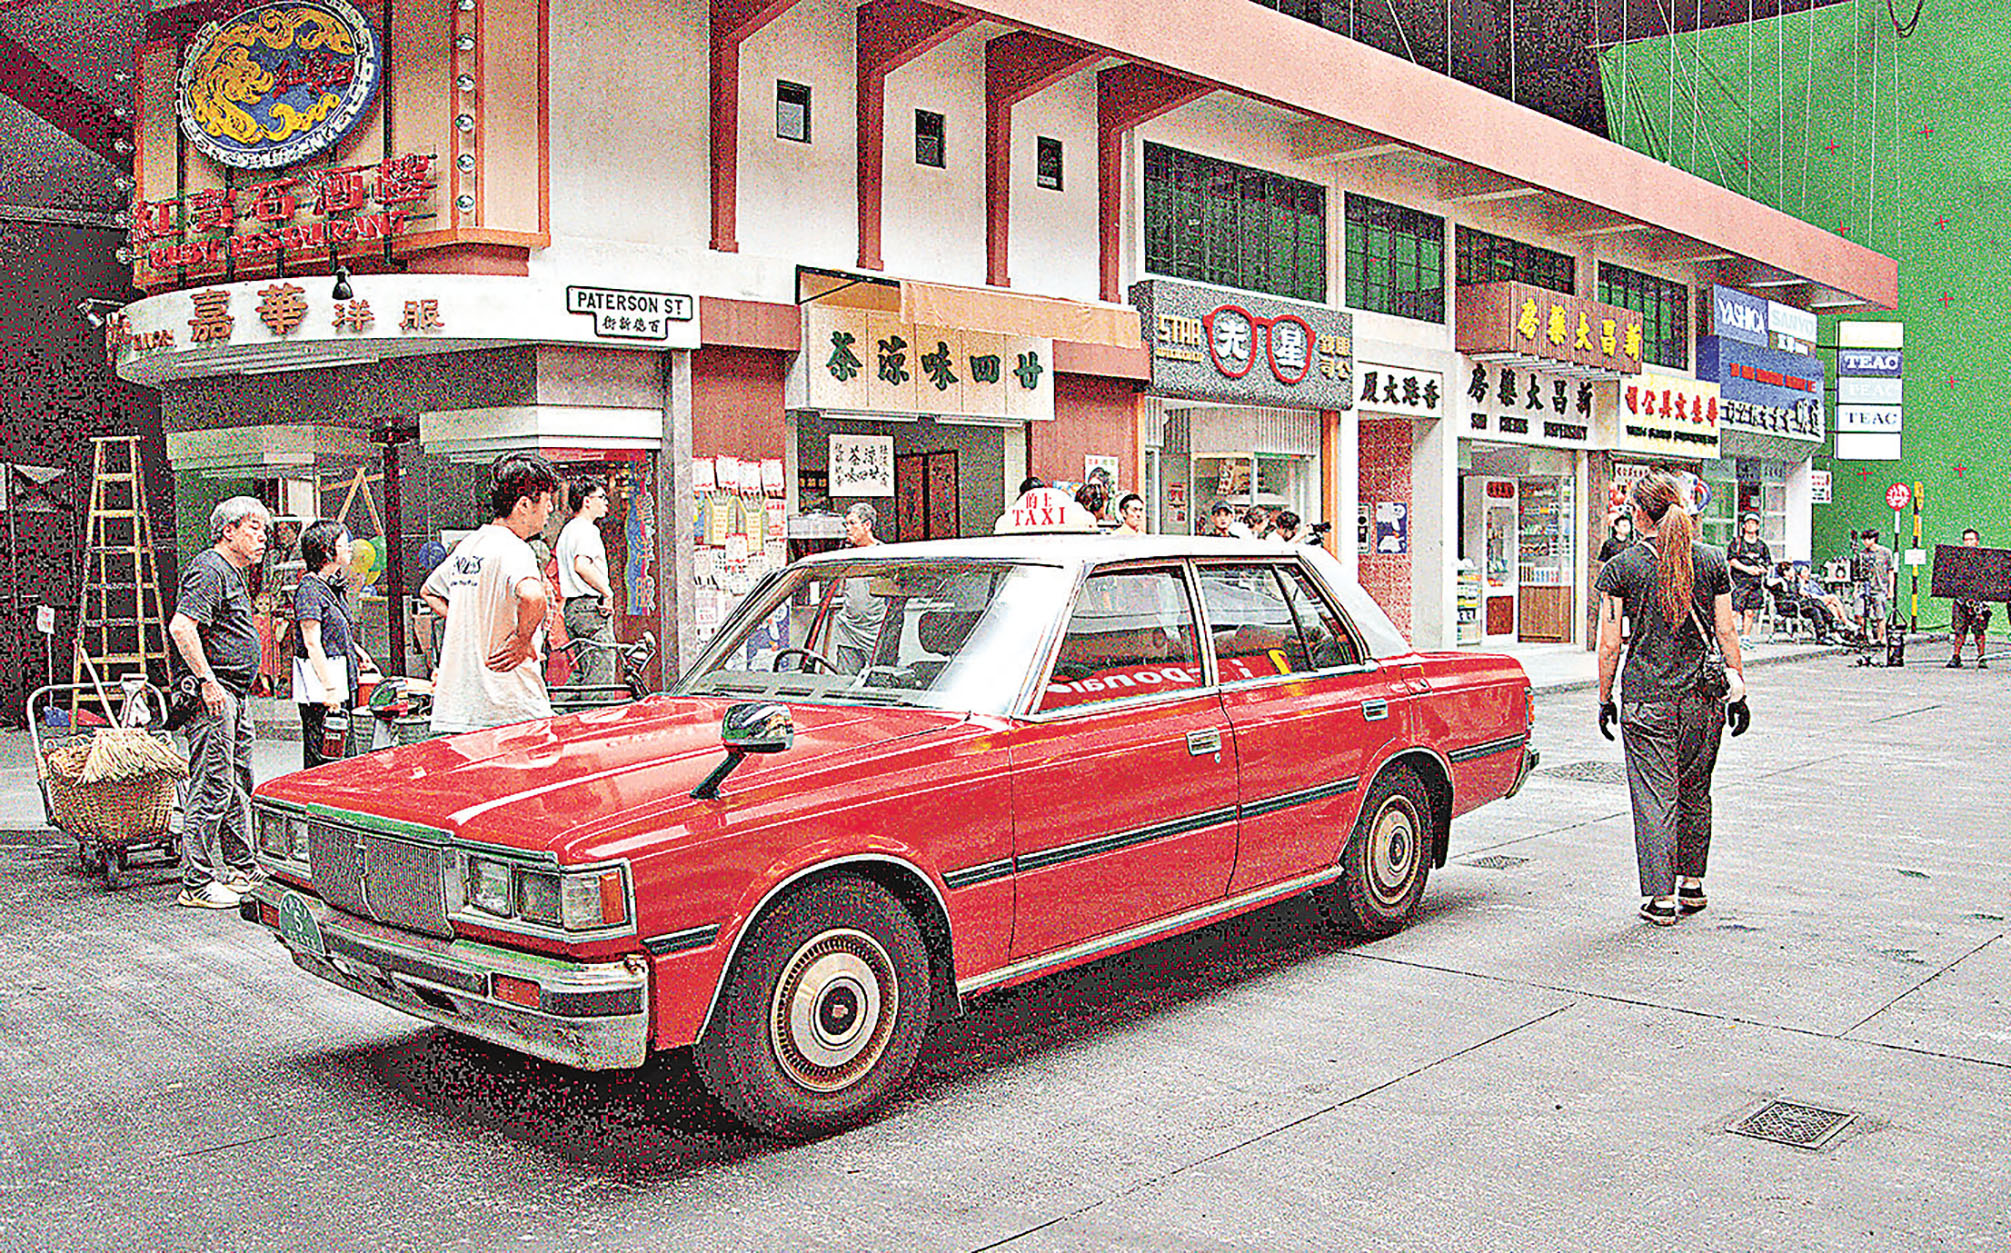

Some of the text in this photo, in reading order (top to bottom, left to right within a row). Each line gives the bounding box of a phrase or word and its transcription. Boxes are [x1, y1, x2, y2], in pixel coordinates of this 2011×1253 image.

[577, 291, 658, 312] PATERSON
[188, 282, 446, 343] 嘉華洋服
[1158, 315, 1202, 346] STAR
[1845, 411, 1898, 424] TEAC
[1012, 507, 1065, 527] TAXI
